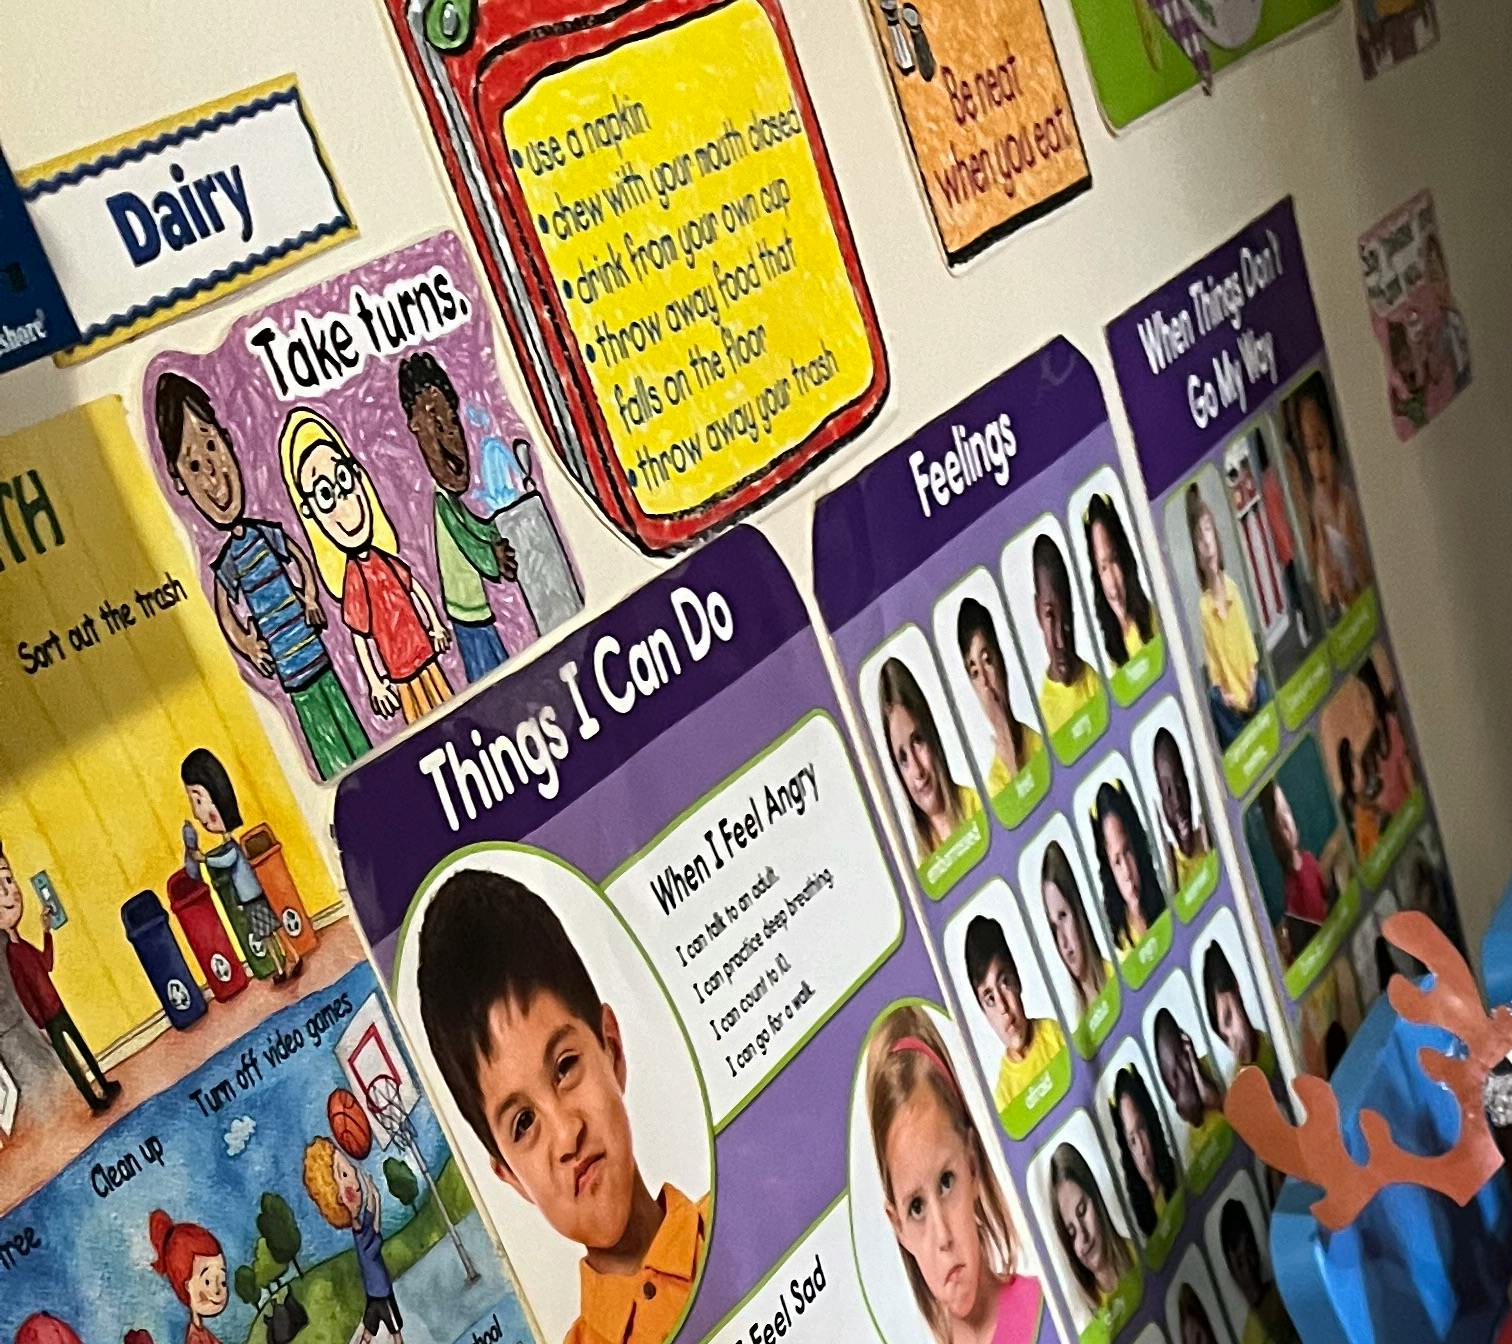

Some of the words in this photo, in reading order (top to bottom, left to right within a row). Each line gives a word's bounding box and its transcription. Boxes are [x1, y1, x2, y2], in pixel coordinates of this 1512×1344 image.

[527, 136, 566, 176] use
[566, 129, 584, 158] a
[584, 95, 652, 158] napkin
[940, 66, 977, 125] Be
[975, 42, 1024, 115] neat
[553, 192, 604, 240] chew
[603, 162, 650, 217] with
[651, 153, 693, 209] your
[695, 118, 748, 177] mouth
[748, 93, 801, 151] closed
[933, 140, 996, 208] when
[994, 126, 1036, 198] you
[1034, 93, 1073, 159] eat
[106, 163, 253, 267] Dairy
[577, 243, 630, 303] drink
[624, 232, 679, 284] from
[678, 211, 718, 269] your
[722, 193, 759, 232] own
[760, 178, 790, 221] cup
[251, 317, 359, 396] Take
[355, 273, 468, 352] turns.
[596, 312, 661, 367] throw
[666, 285, 720, 331] away
[712, 250, 761, 309] food
[756, 228, 797, 284] that
[1137, 310, 1195, 375] When
[1188, 271, 1245, 336] Things
[614, 376, 663, 434] falls
[664, 370, 693, 405] on
[689, 344, 725, 390] the
[720, 325, 767, 374] floor
[637, 434, 703, 492] throw
[706, 401, 759, 452] away
[759, 377, 791, 434] your
[791, 339, 840, 396] trash
[1188, 374, 1219, 429] Go
[1212, 350, 1247, 414] My
[1237, 328, 1278, 385] Way
[909, 413, 1017, 518] Feelings
[0, 469, 65, 573] TH
[18, 630, 66, 674] Sort
[68, 613, 101, 651] out
[99, 600, 136, 635] the
[134, 571, 188, 618] trash
[418, 705, 569, 832] Things
[558, 661, 600, 740] I
[594, 628, 682, 714] Can
[670, 587, 734, 662] Do
[650, 855, 711, 916] When
[704, 830, 724, 869] I
[718, 797, 764, 858] Feel
[764, 762, 819, 824] Angry
[676, 945, 687, 967] I
[687, 933, 708, 959] can
[705, 911, 728, 942] talk
[724, 905, 739, 923] to
[738, 892, 753, 912] an
[693, 982, 705, 1004] I
[704, 970, 725, 996] can
[723, 932, 764, 985] practice
[762, 910, 788, 939] deep
[188, 1079, 237, 1117] Turn
[236, 1047, 263, 1089] off
[263, 1029, 304, 1068] video
[306, 992, 352, 1047] games
[709, 1019, 721, 1040] I
[721, 1007, 741, 1032] can
[740, 976, 769, 1012] count
[765, 968, 779, 986] to
[725, 1056, 737, 1078] I
[737, 1042, 758, 1069] can
[755, 1029, 770, 1055] go
[767, 1012, 784, 1035] for
[785, 1005, 794, 1020] a
[90, 1152, 143, 1198] Clean
[139, 1136, 165, 1167] up
[790, 1253, 827, 1315] Sad
